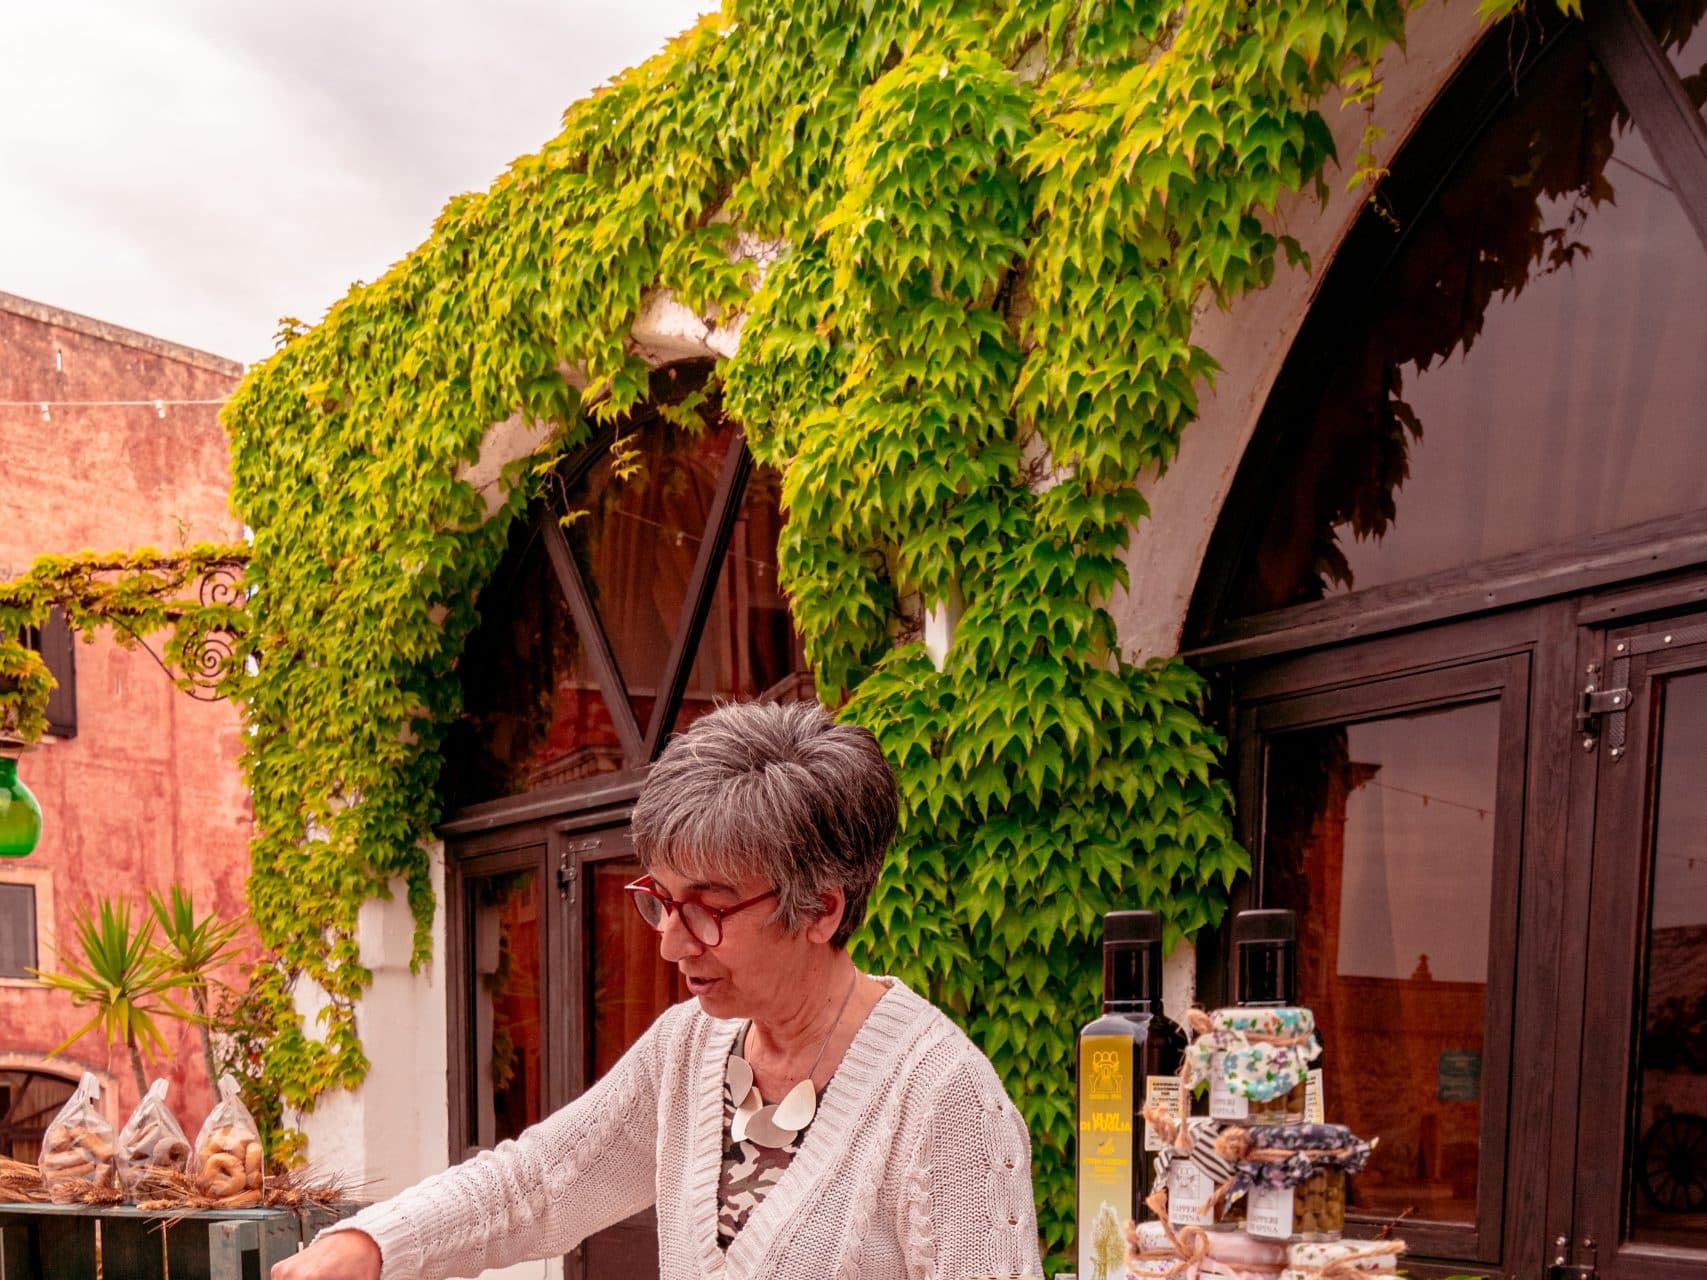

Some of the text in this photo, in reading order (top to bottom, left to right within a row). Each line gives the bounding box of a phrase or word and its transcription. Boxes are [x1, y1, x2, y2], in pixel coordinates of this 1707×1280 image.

[1092, 1112, 1120, 1121] ULIVI
[1080, 1121, 1131, 1131] DI PUGLIA
